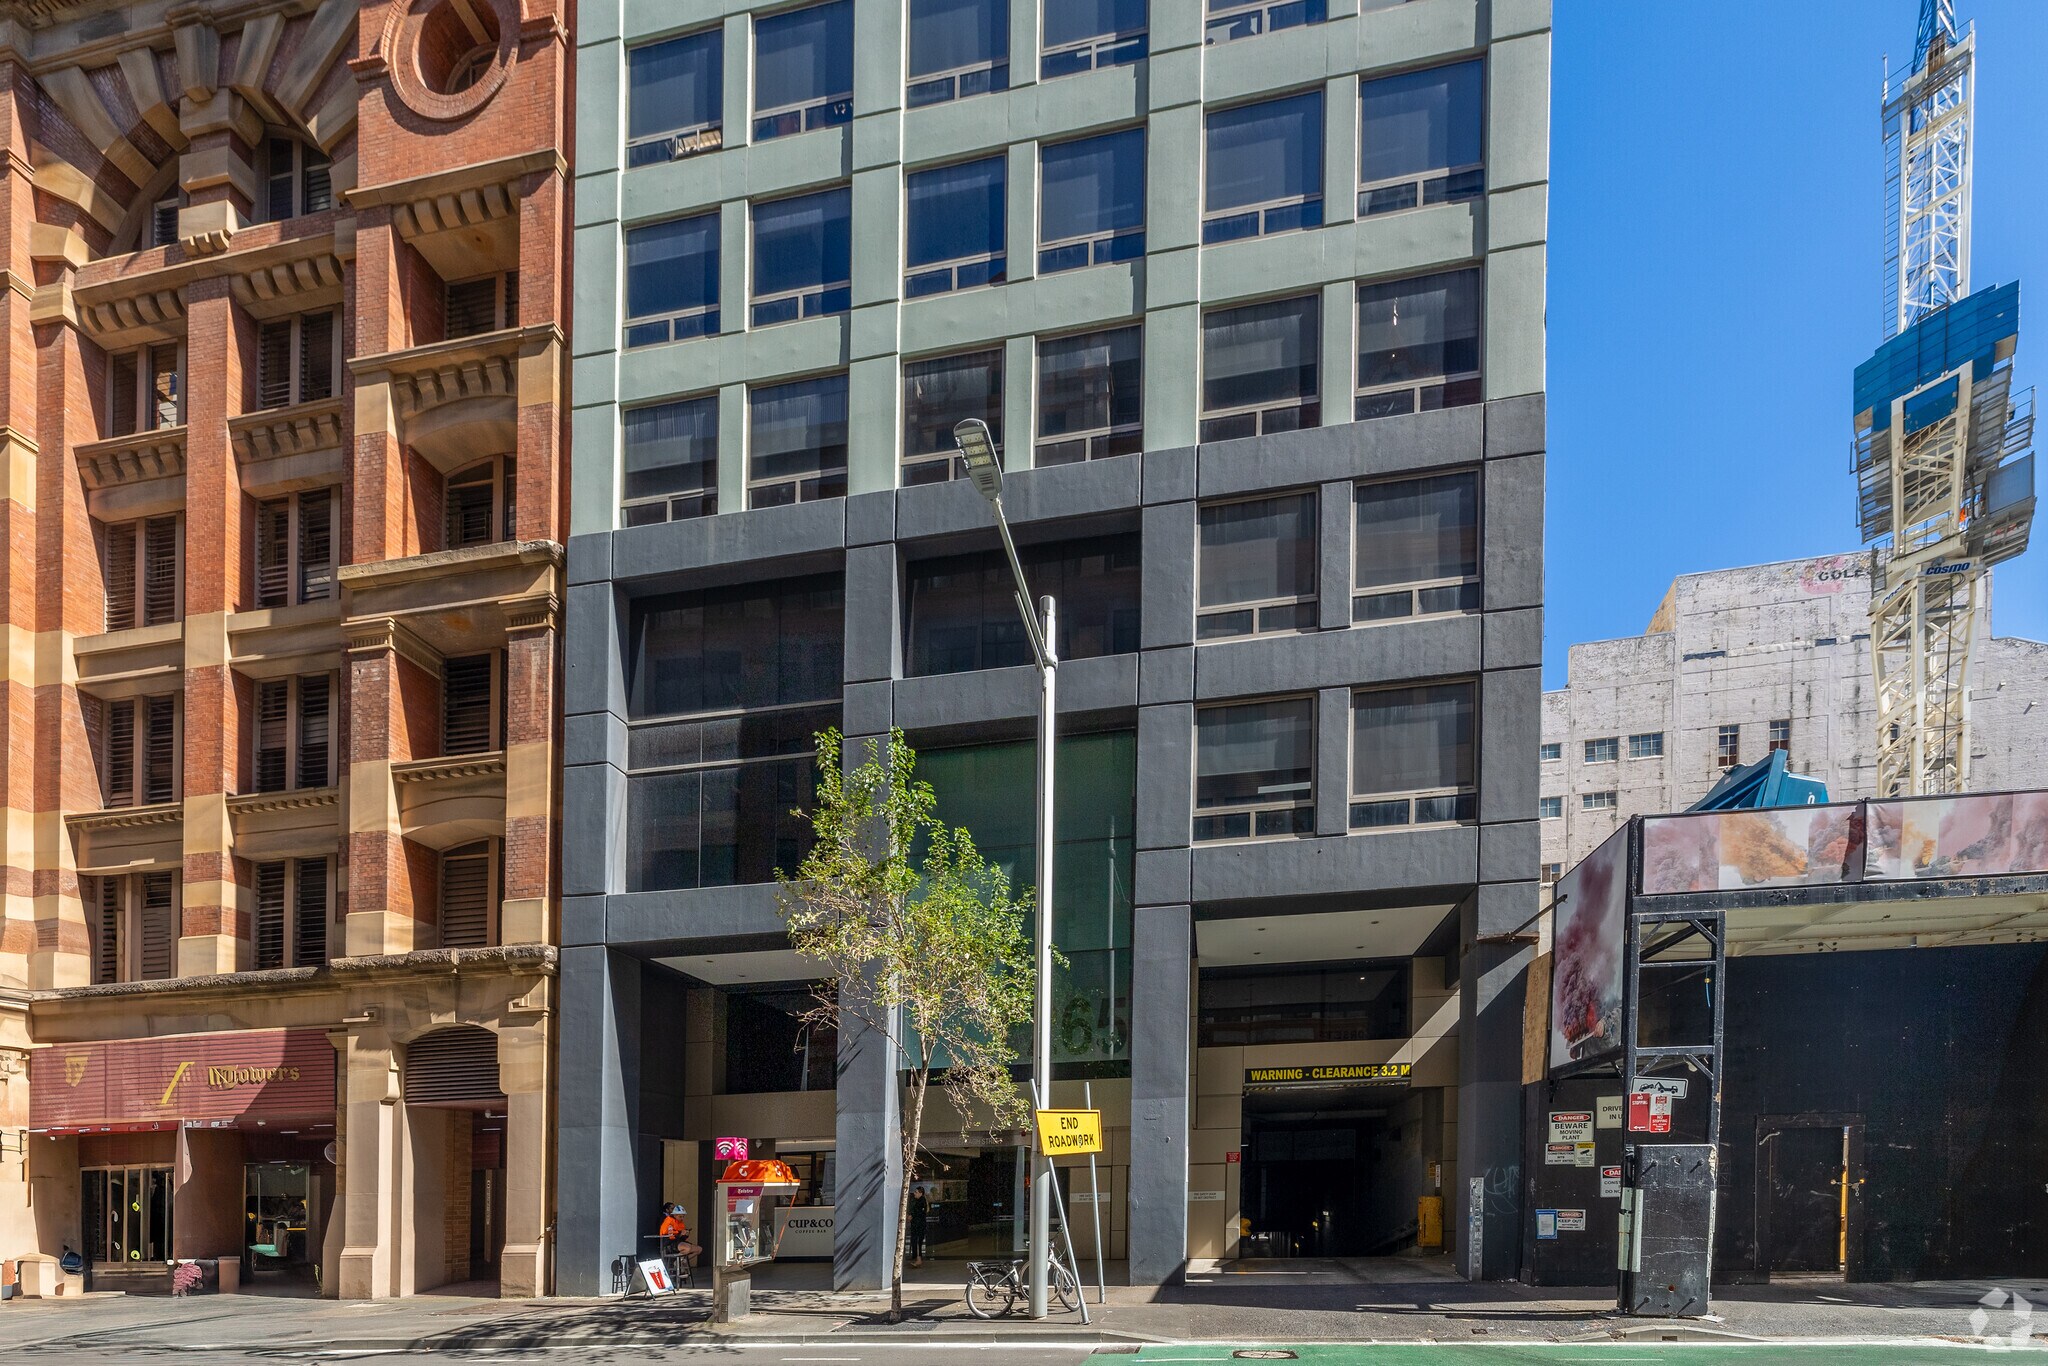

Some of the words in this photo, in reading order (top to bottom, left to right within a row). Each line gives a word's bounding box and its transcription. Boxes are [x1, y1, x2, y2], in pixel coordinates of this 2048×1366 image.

[1251, 1069, 1303, 1081] WARNING
[1312, 1066, 1378, 1079] CLEARANCE
[1381, 1065, 1398, 1077] 3.2
[1060, 1117, 1079, 1130] END
[1048, 1134, 1096, 1148] ROADWORK
[788, 1218, 834, 1229] CUP&CO
